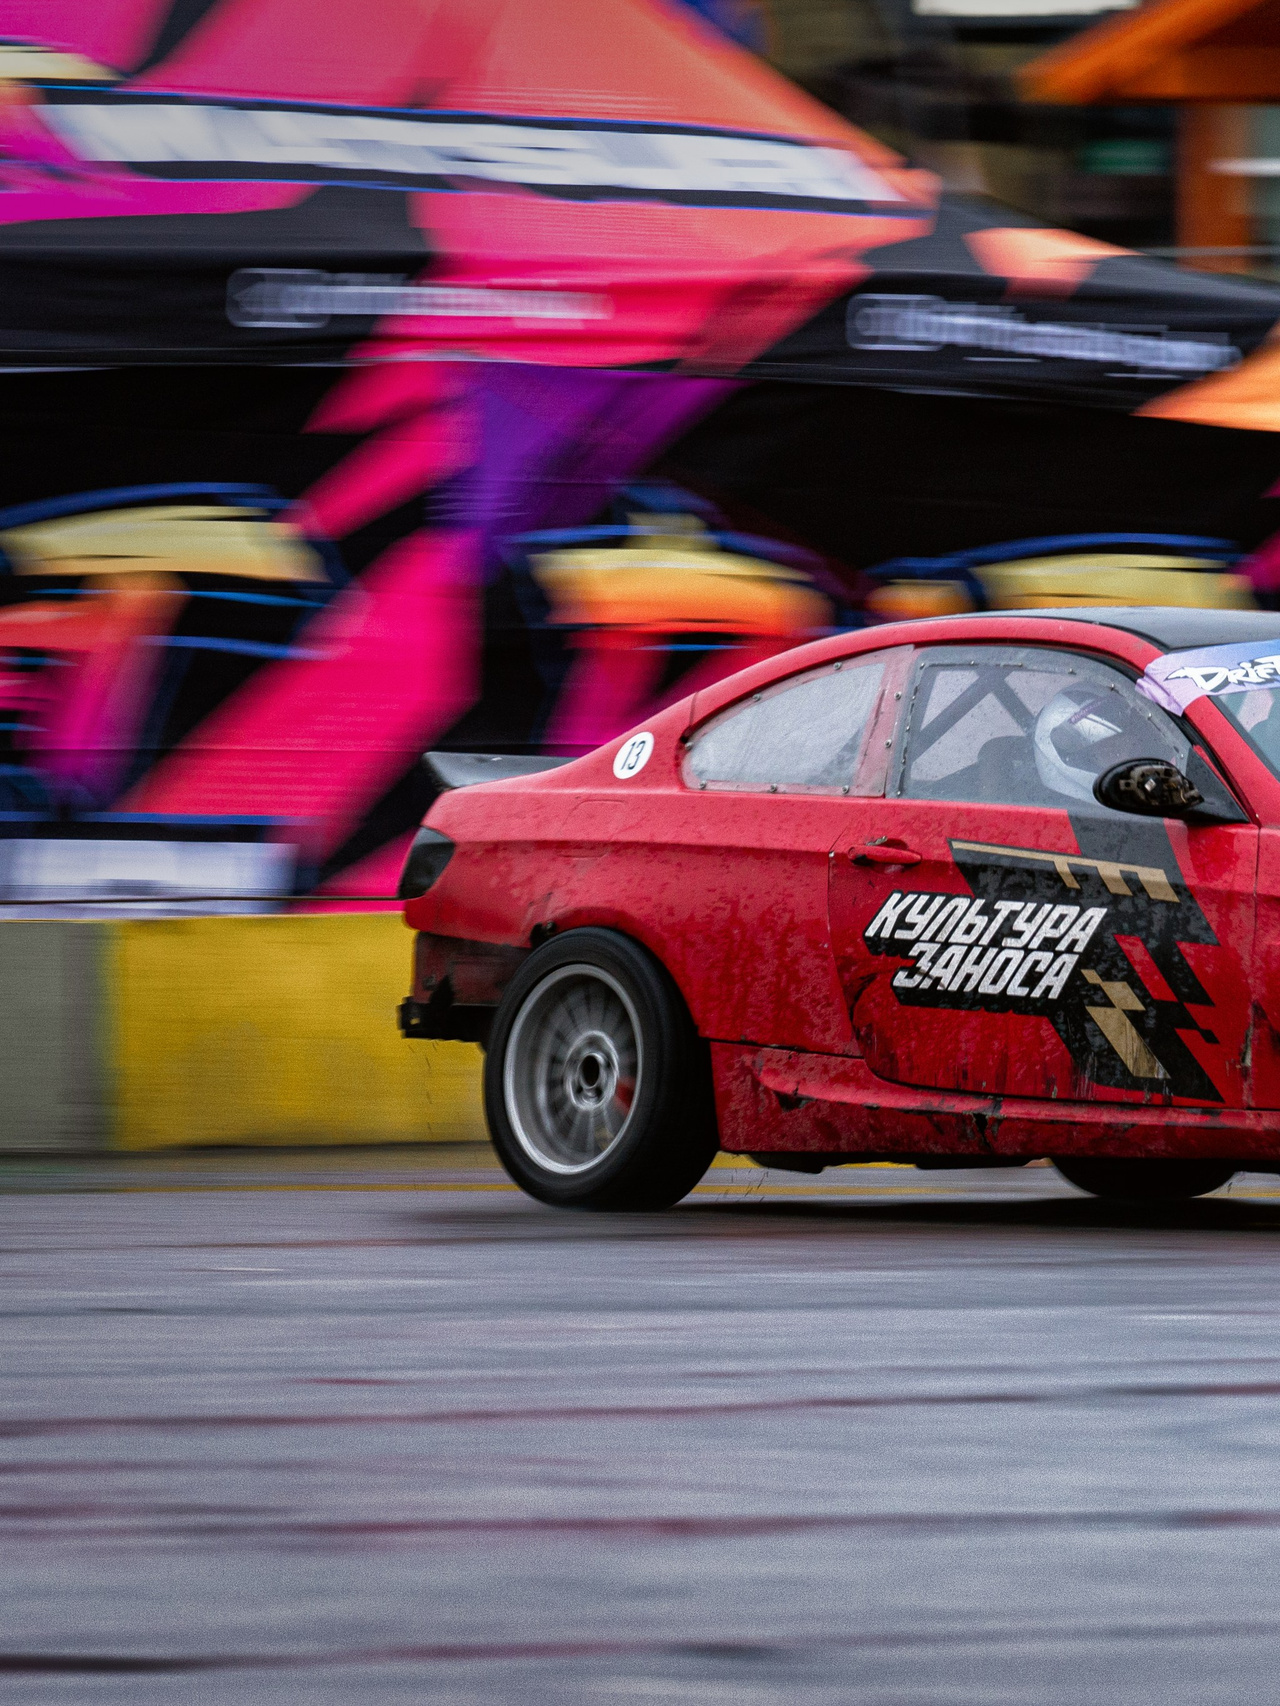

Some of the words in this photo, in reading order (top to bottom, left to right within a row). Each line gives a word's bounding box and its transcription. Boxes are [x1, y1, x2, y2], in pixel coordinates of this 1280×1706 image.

[620, 740, 647, 771] 13
[863, 892, 1108, 954] КУЛЬТУРА
[892, 942, 1079, 1000] ЗАНОСА
